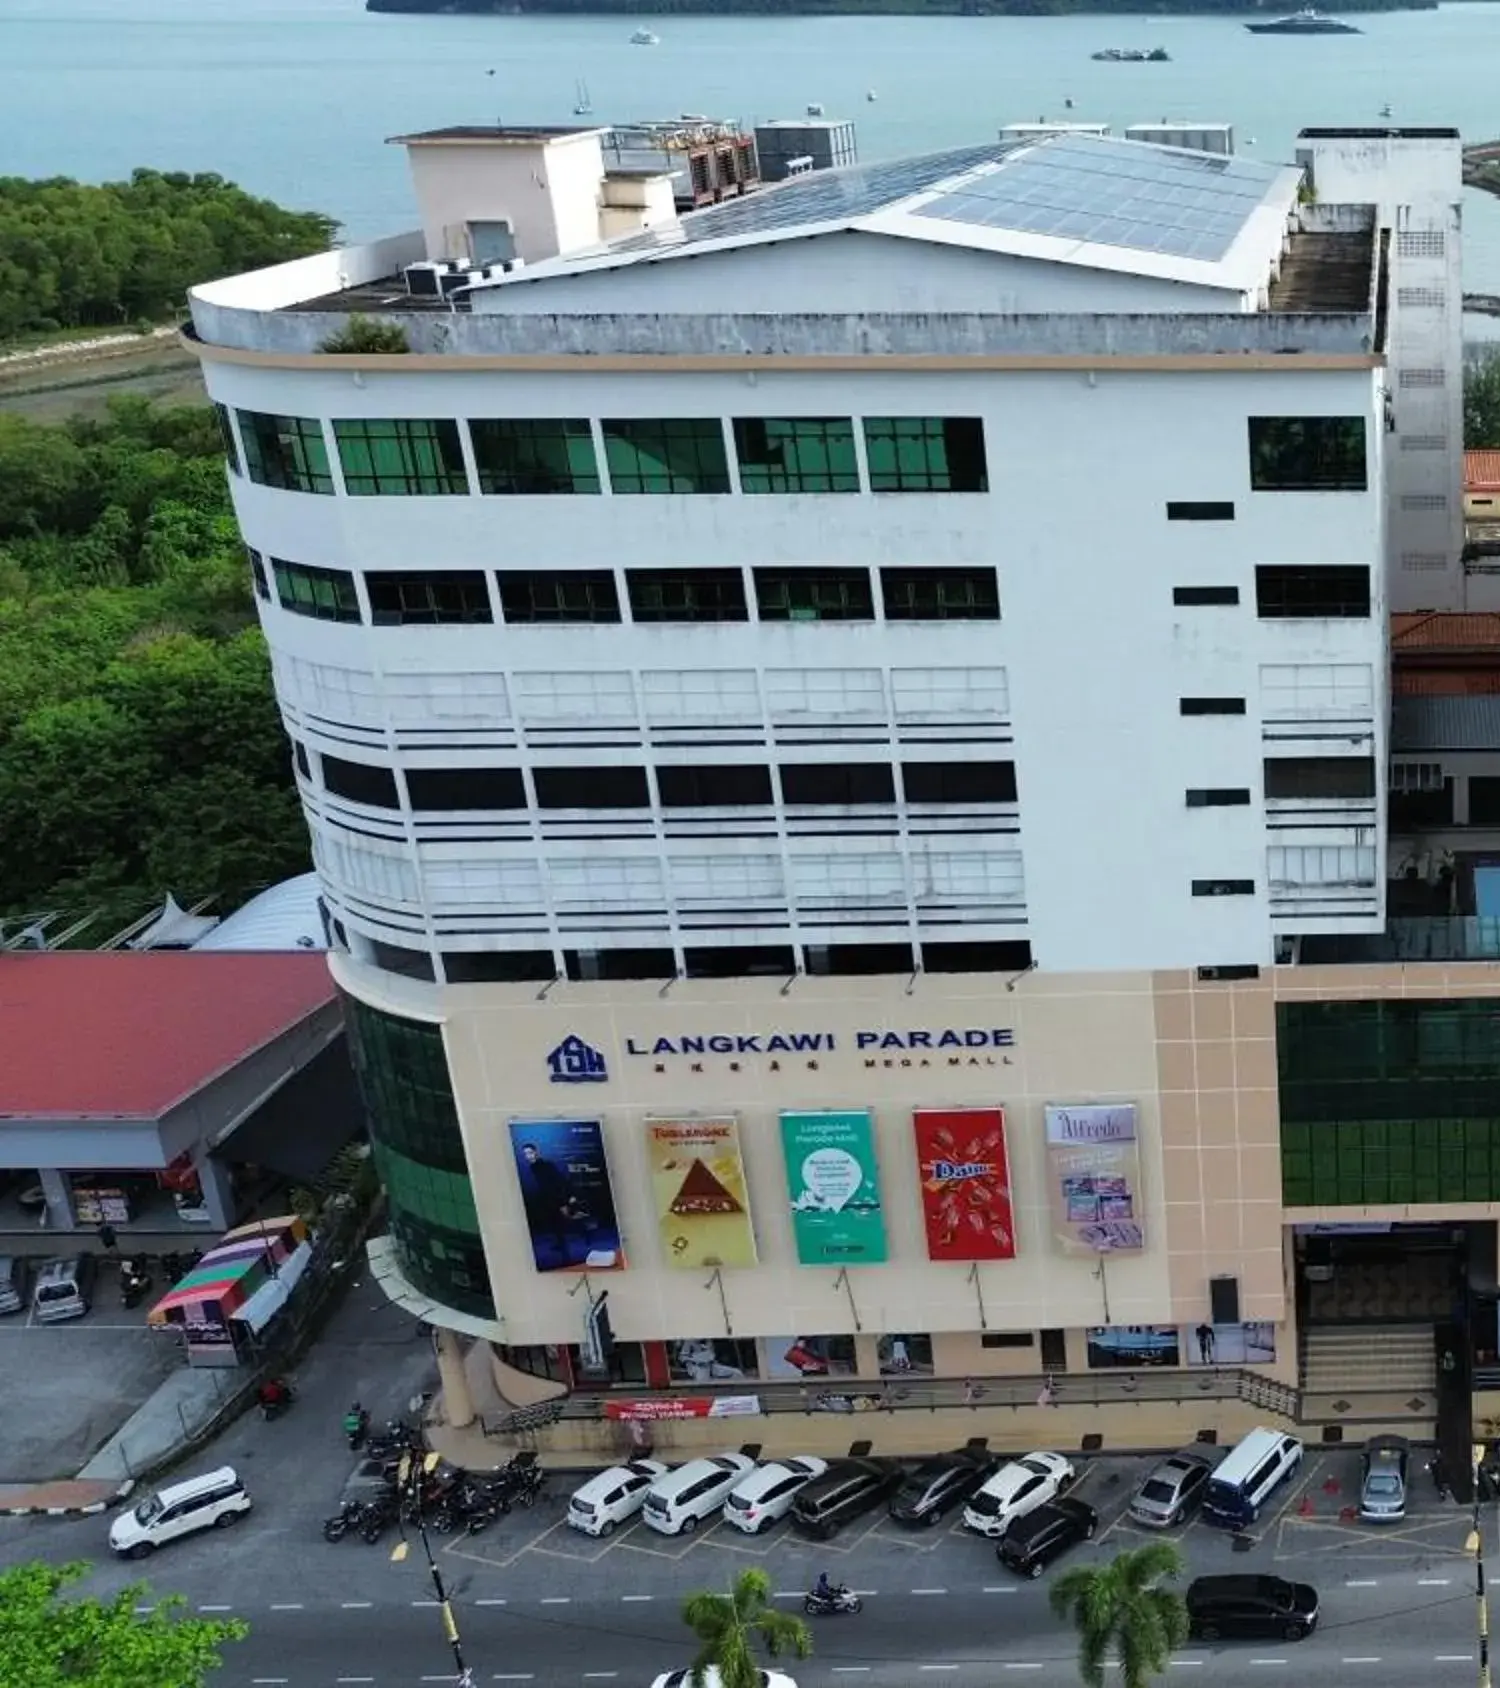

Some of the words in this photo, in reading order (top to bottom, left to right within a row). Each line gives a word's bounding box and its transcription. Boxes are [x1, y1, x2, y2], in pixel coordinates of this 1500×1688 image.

[625, 1033, 836, 1056] LANGKAWI
[856, 1028, 1016, 1049] PARADE
[864, 1057, 931, 1069] MEGA
[948, 1055, 1013, 1066] MALL
